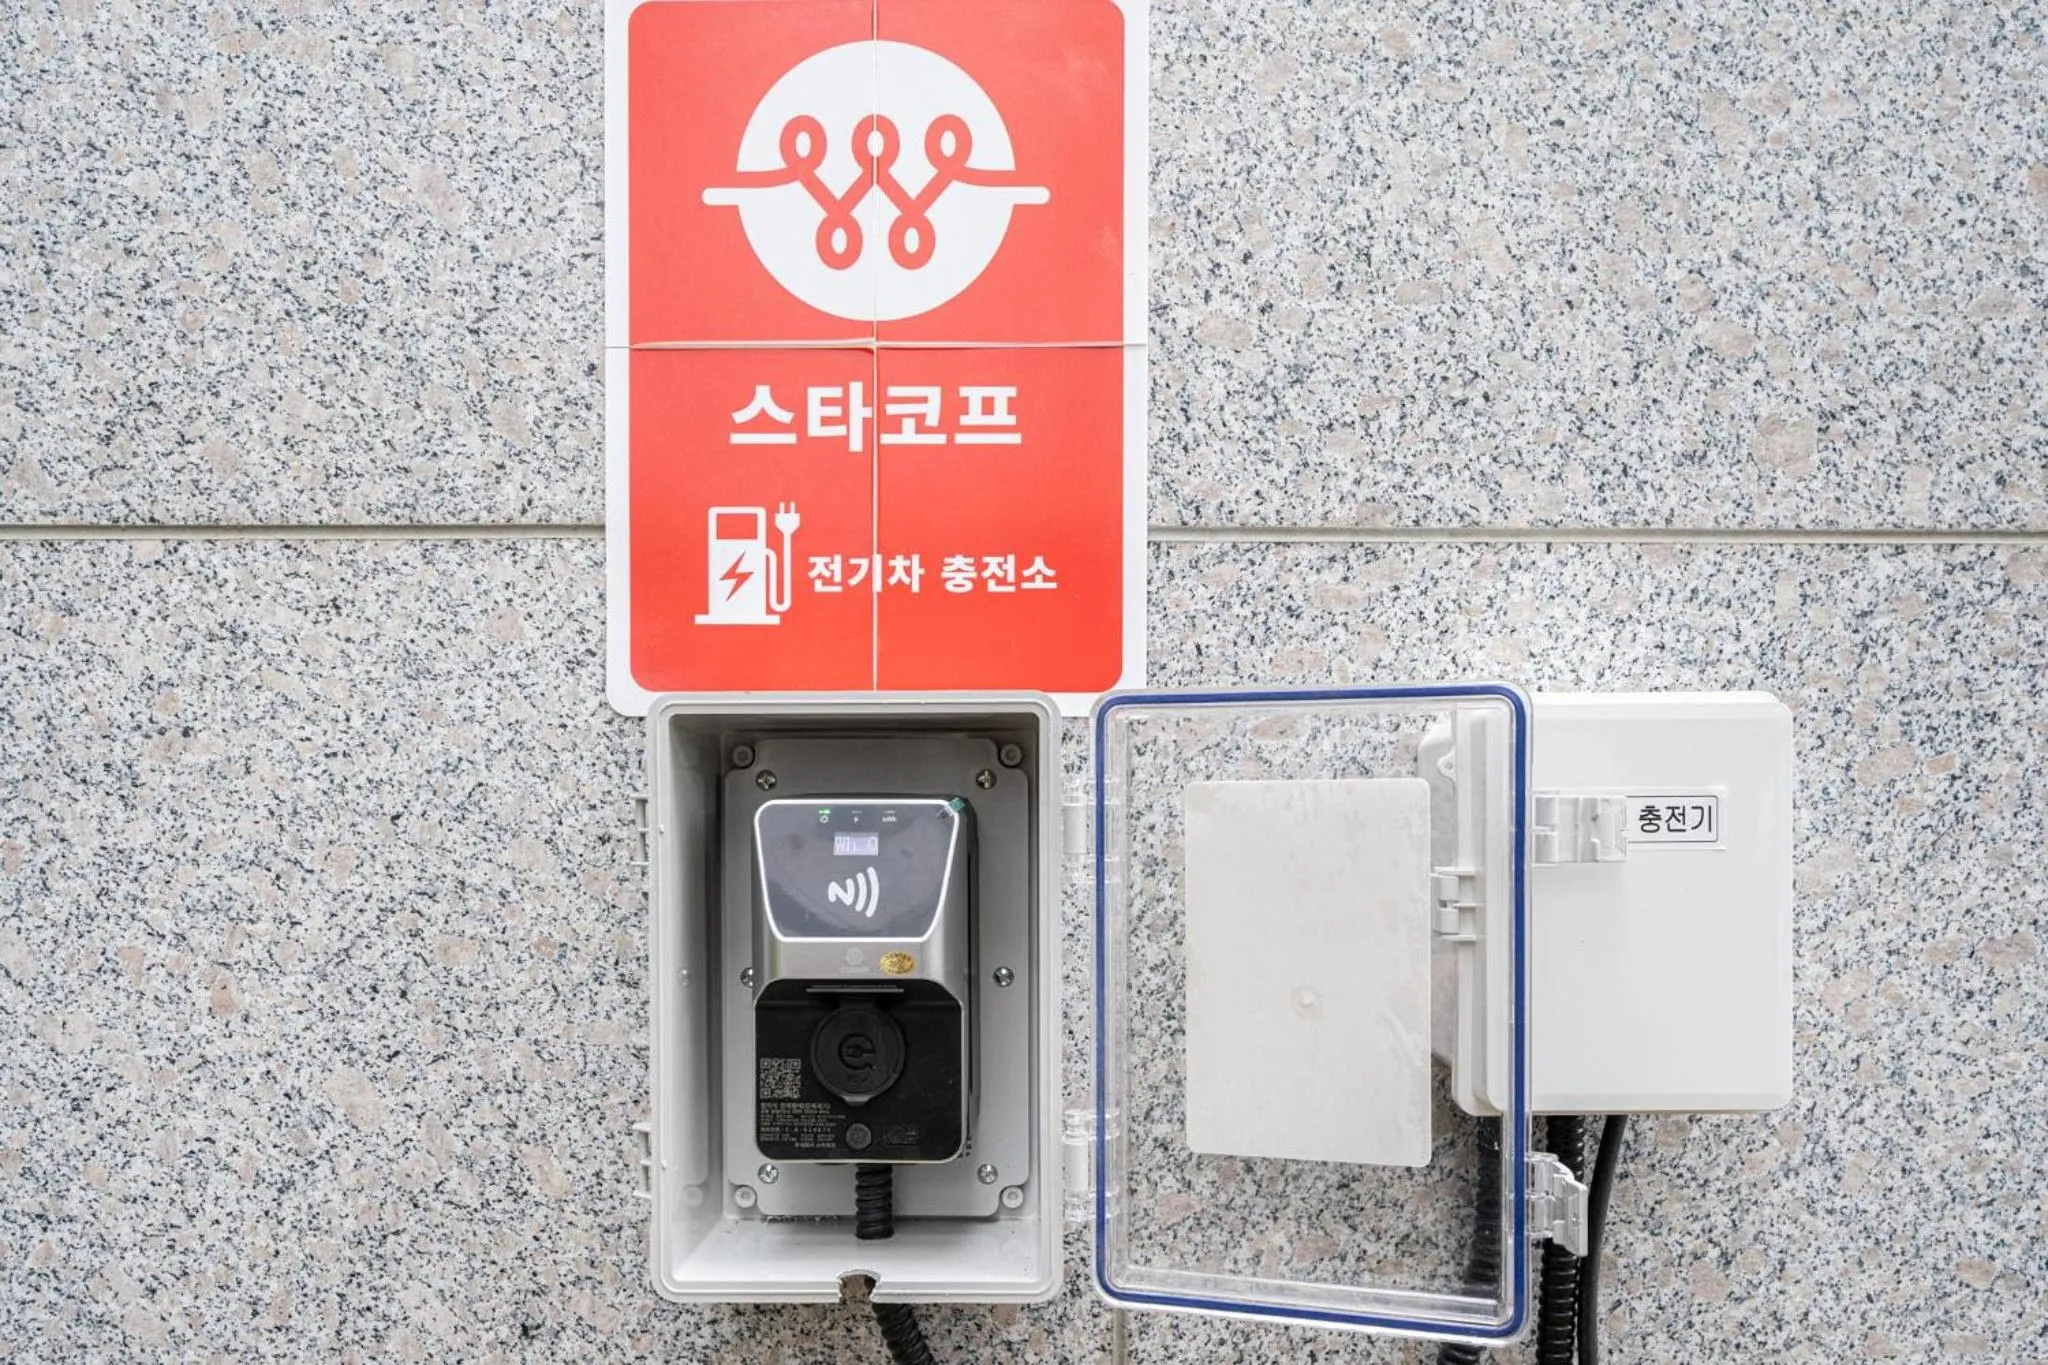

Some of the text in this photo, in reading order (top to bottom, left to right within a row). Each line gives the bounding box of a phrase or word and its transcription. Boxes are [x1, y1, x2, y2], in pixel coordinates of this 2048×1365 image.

[729, 381, 1022, 452] 스타코프
[807, 554, 1059, 593] 전기차 충전소
[1638, 804, 1713, 834] 충전기
